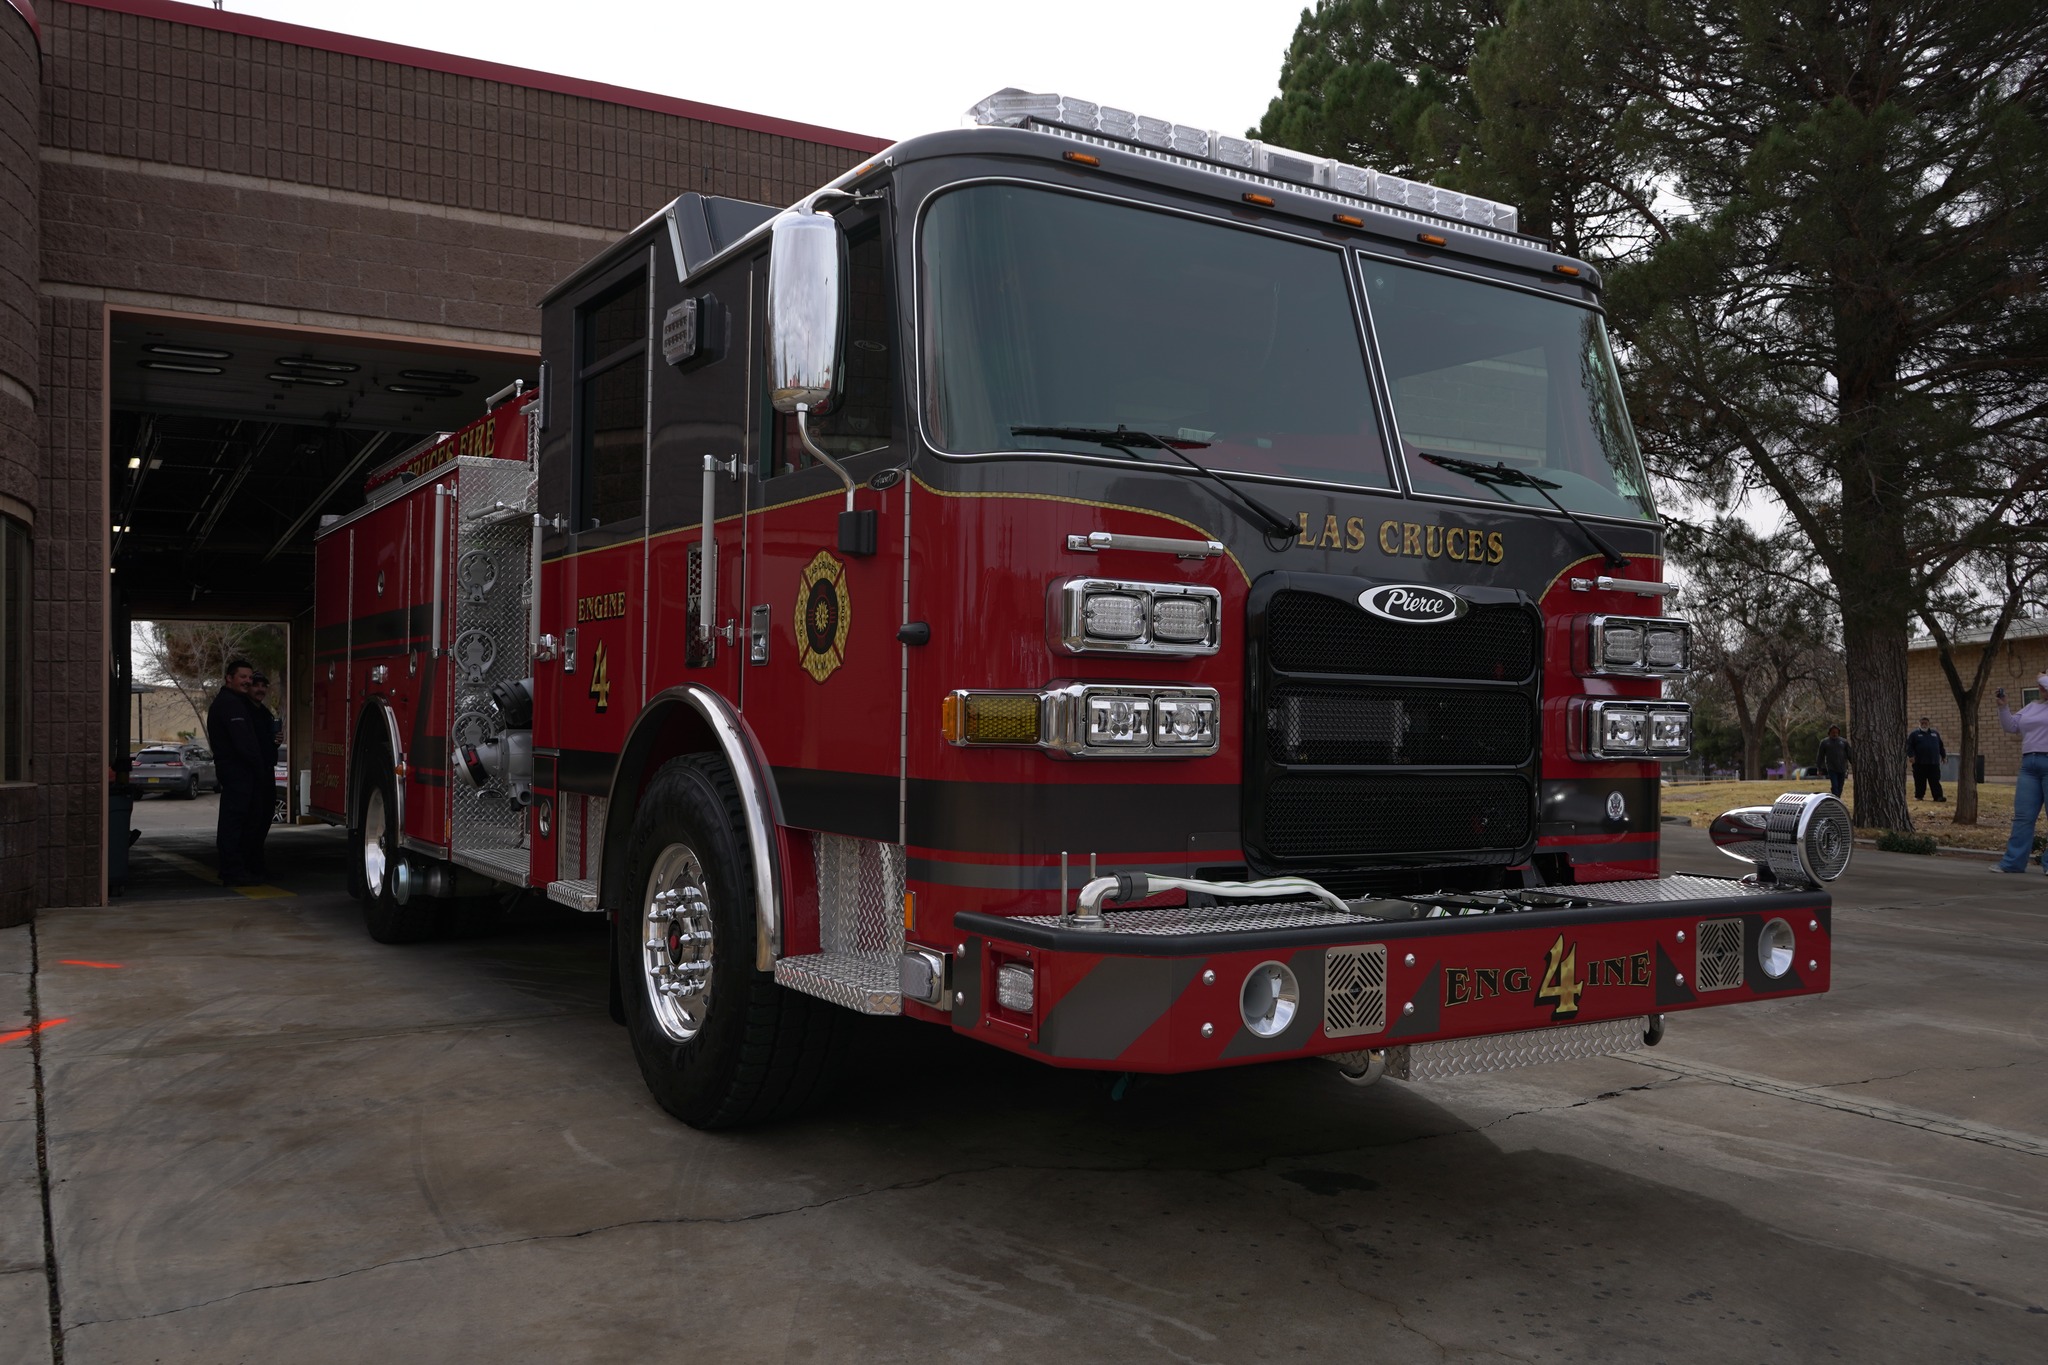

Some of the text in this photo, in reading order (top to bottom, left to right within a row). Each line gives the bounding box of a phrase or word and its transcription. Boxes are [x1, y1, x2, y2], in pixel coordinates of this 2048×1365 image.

[459, 417, 496, 457] FIRE
[1297, 511, 1504, 564] LAS CRUCES
[578, 592, 626, 621] ENGINE
[1384, 589, 1446, 614] Pierce
[590, 639, 611, 710] 4
[1444, 932, 1652, 1018] ENG 4 INE
